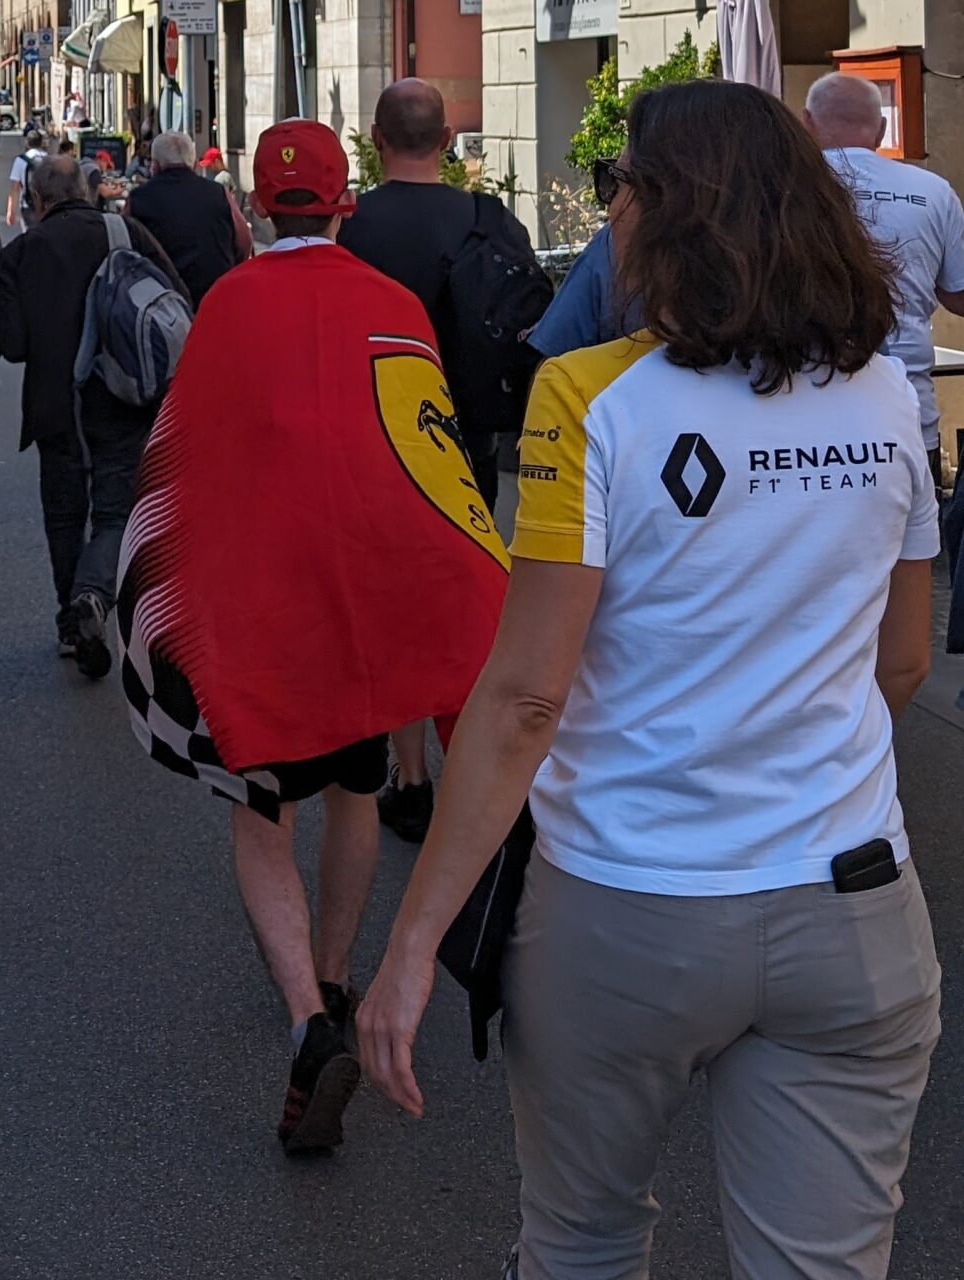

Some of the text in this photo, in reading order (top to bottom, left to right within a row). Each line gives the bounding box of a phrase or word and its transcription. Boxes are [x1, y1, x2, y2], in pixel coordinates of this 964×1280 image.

[854, 189, 928, 207] SCHE
[748, 441, 898, 472] RENAULT
[521, 469, 557, 482] RELLI
[799, 471, 878, 492] TEAM
